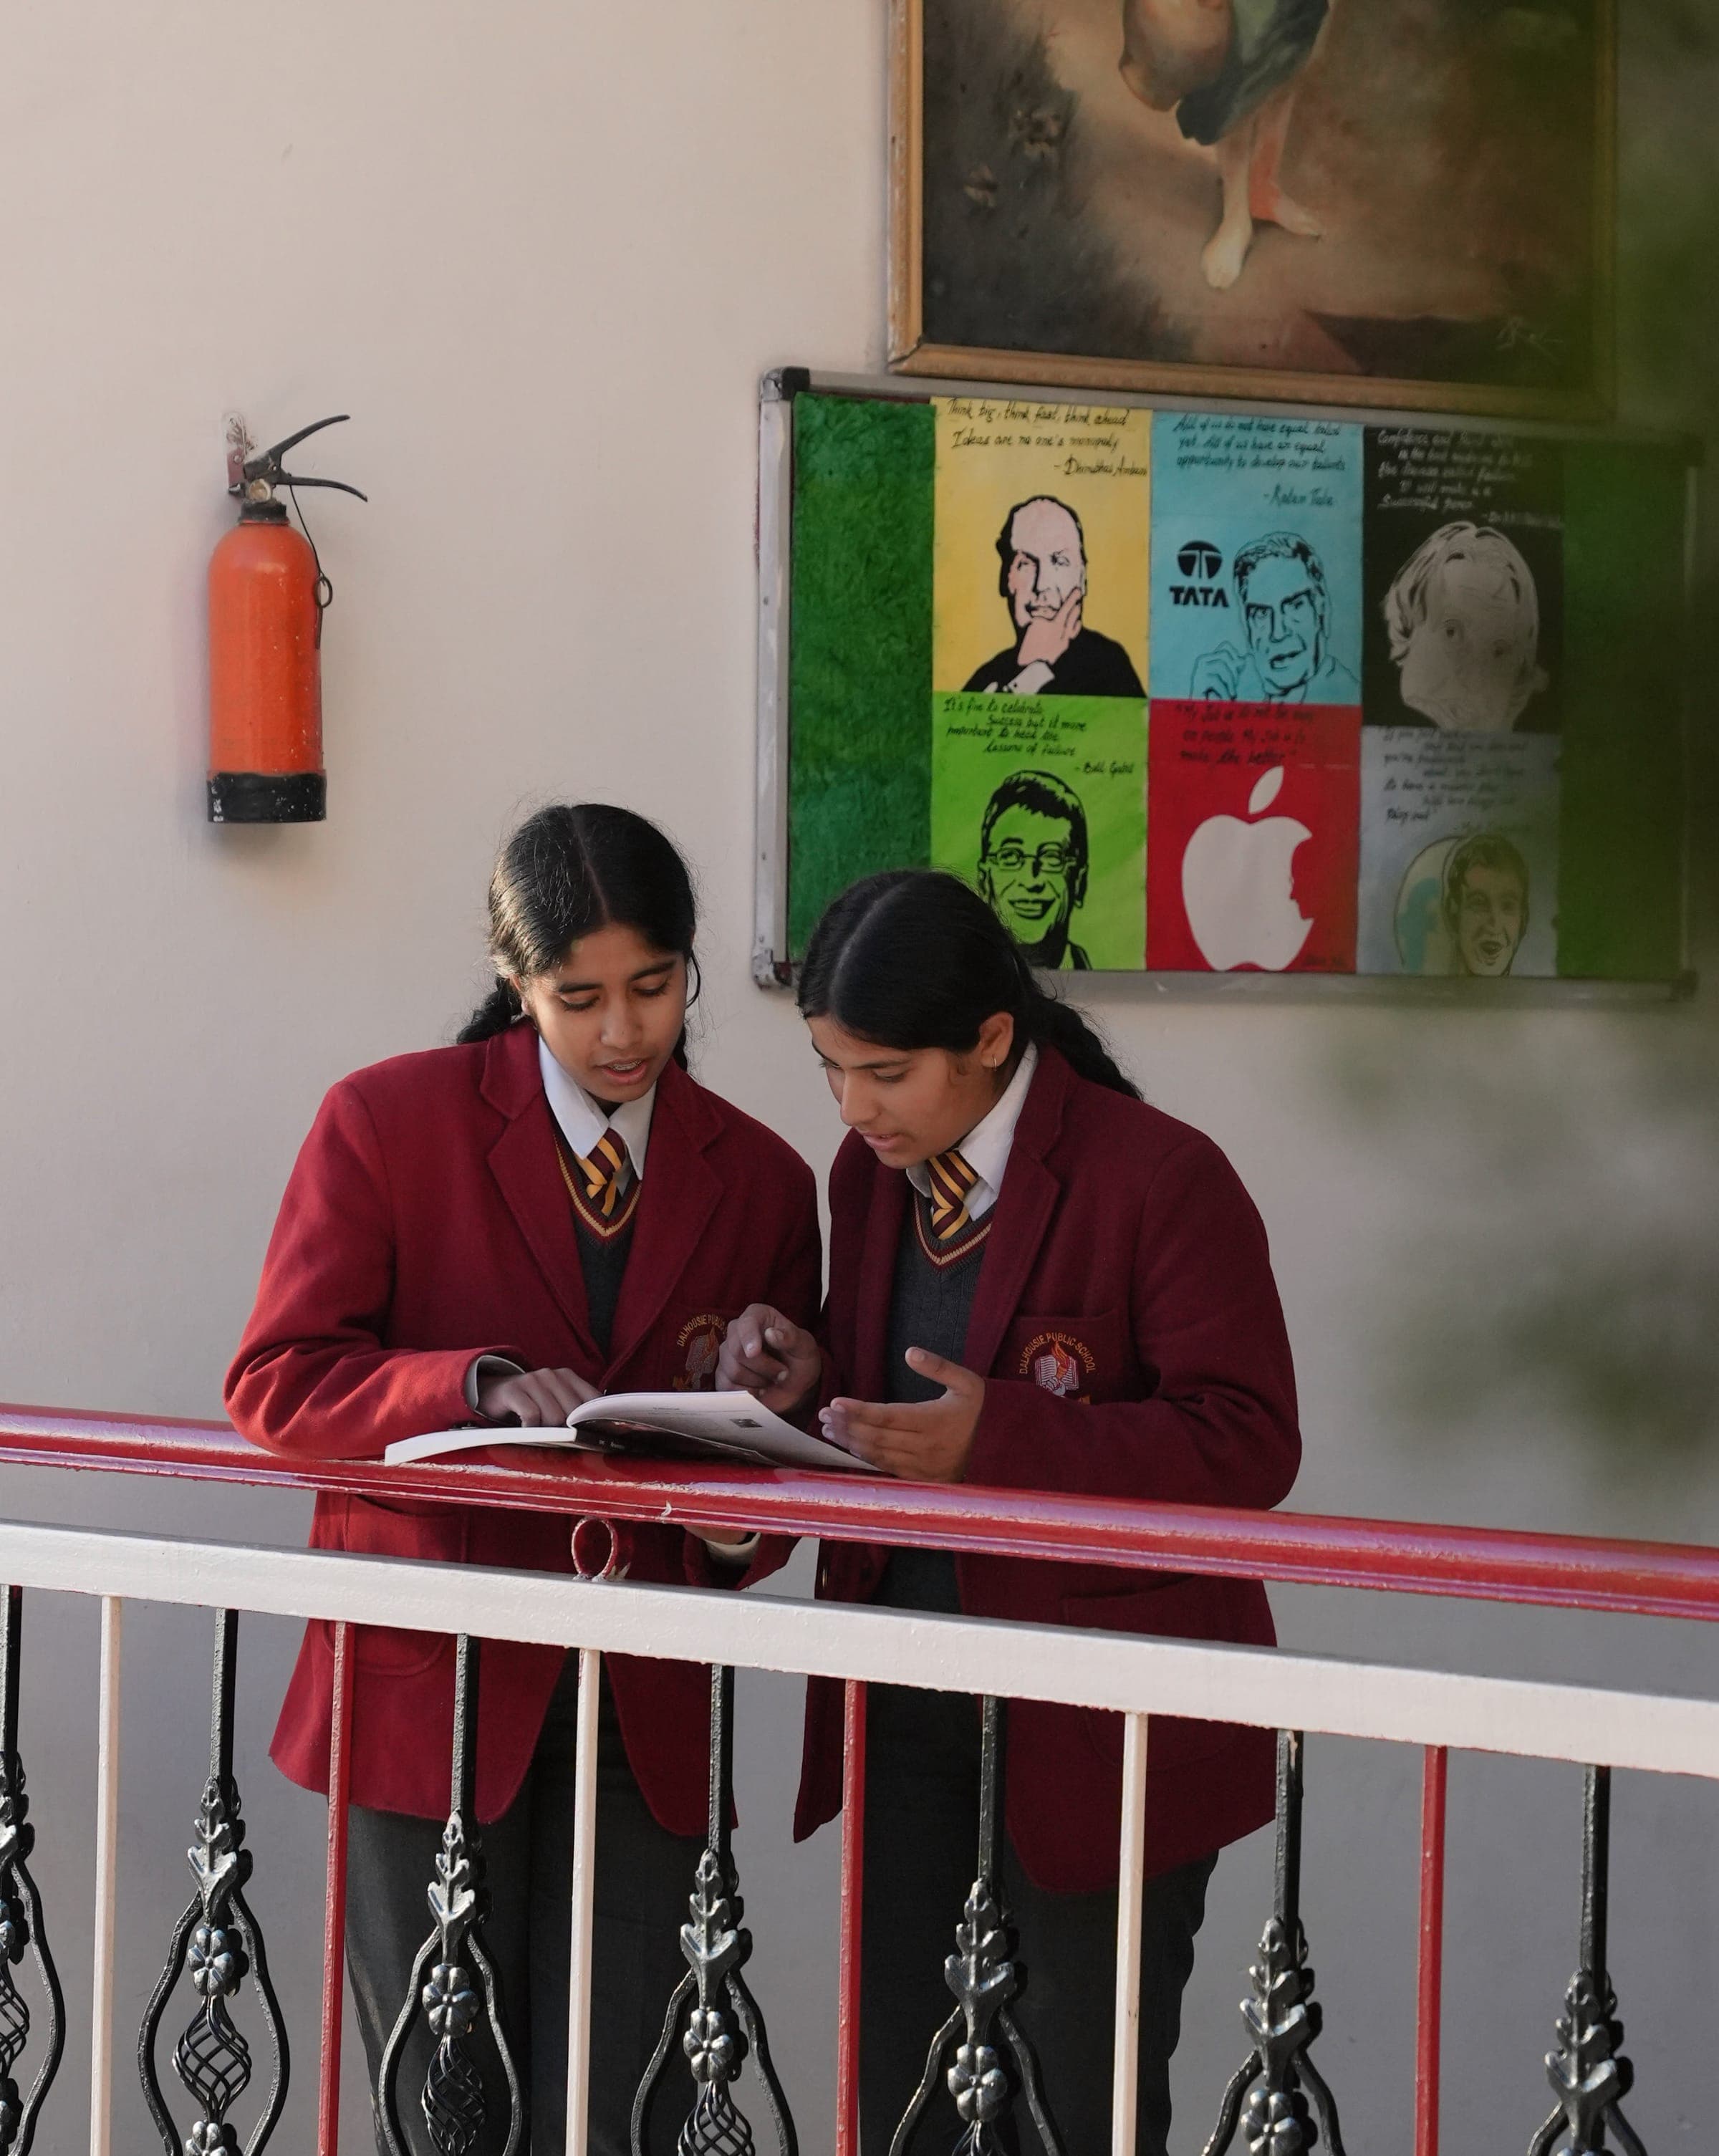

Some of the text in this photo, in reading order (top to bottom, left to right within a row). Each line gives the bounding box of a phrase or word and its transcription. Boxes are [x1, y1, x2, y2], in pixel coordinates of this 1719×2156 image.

[947, 398, 973, 420] Think
[1003, 400, 1029, 423] think
[1064, 404, 1090, 426] think
[950, 425, 991, 449] Ideas
[993, 435, 1013, 446] are
[1018, 435, 1032, 446] no
[1169, 585, 1231, 609] TATA
[1019, 1332, 1096, 1375] DALHOUSIE PUBLIC SCHOOL
